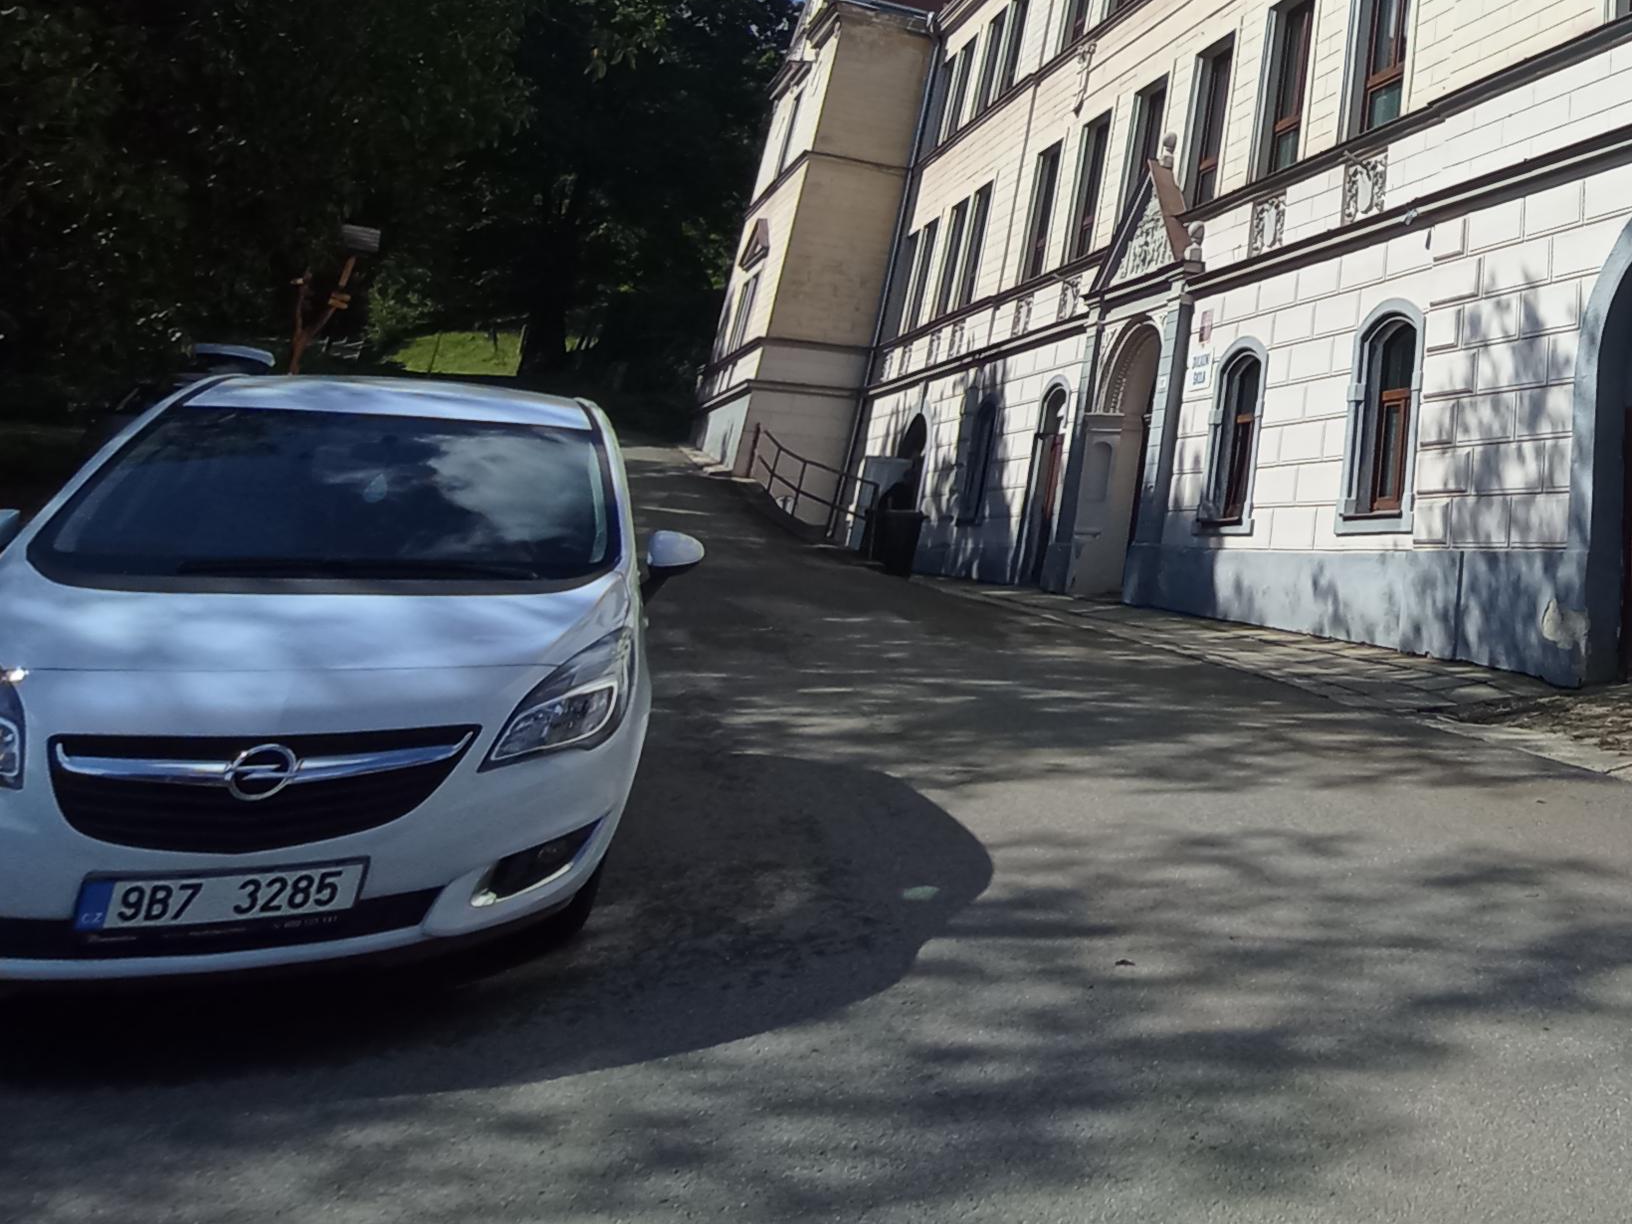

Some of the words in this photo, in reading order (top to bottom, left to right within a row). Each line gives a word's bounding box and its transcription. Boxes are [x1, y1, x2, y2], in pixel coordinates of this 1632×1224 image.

[116, 882, 204, 922] 9B7
[232, 870, 344, 915] 3285
[80, 912, 104, 924] CZ
